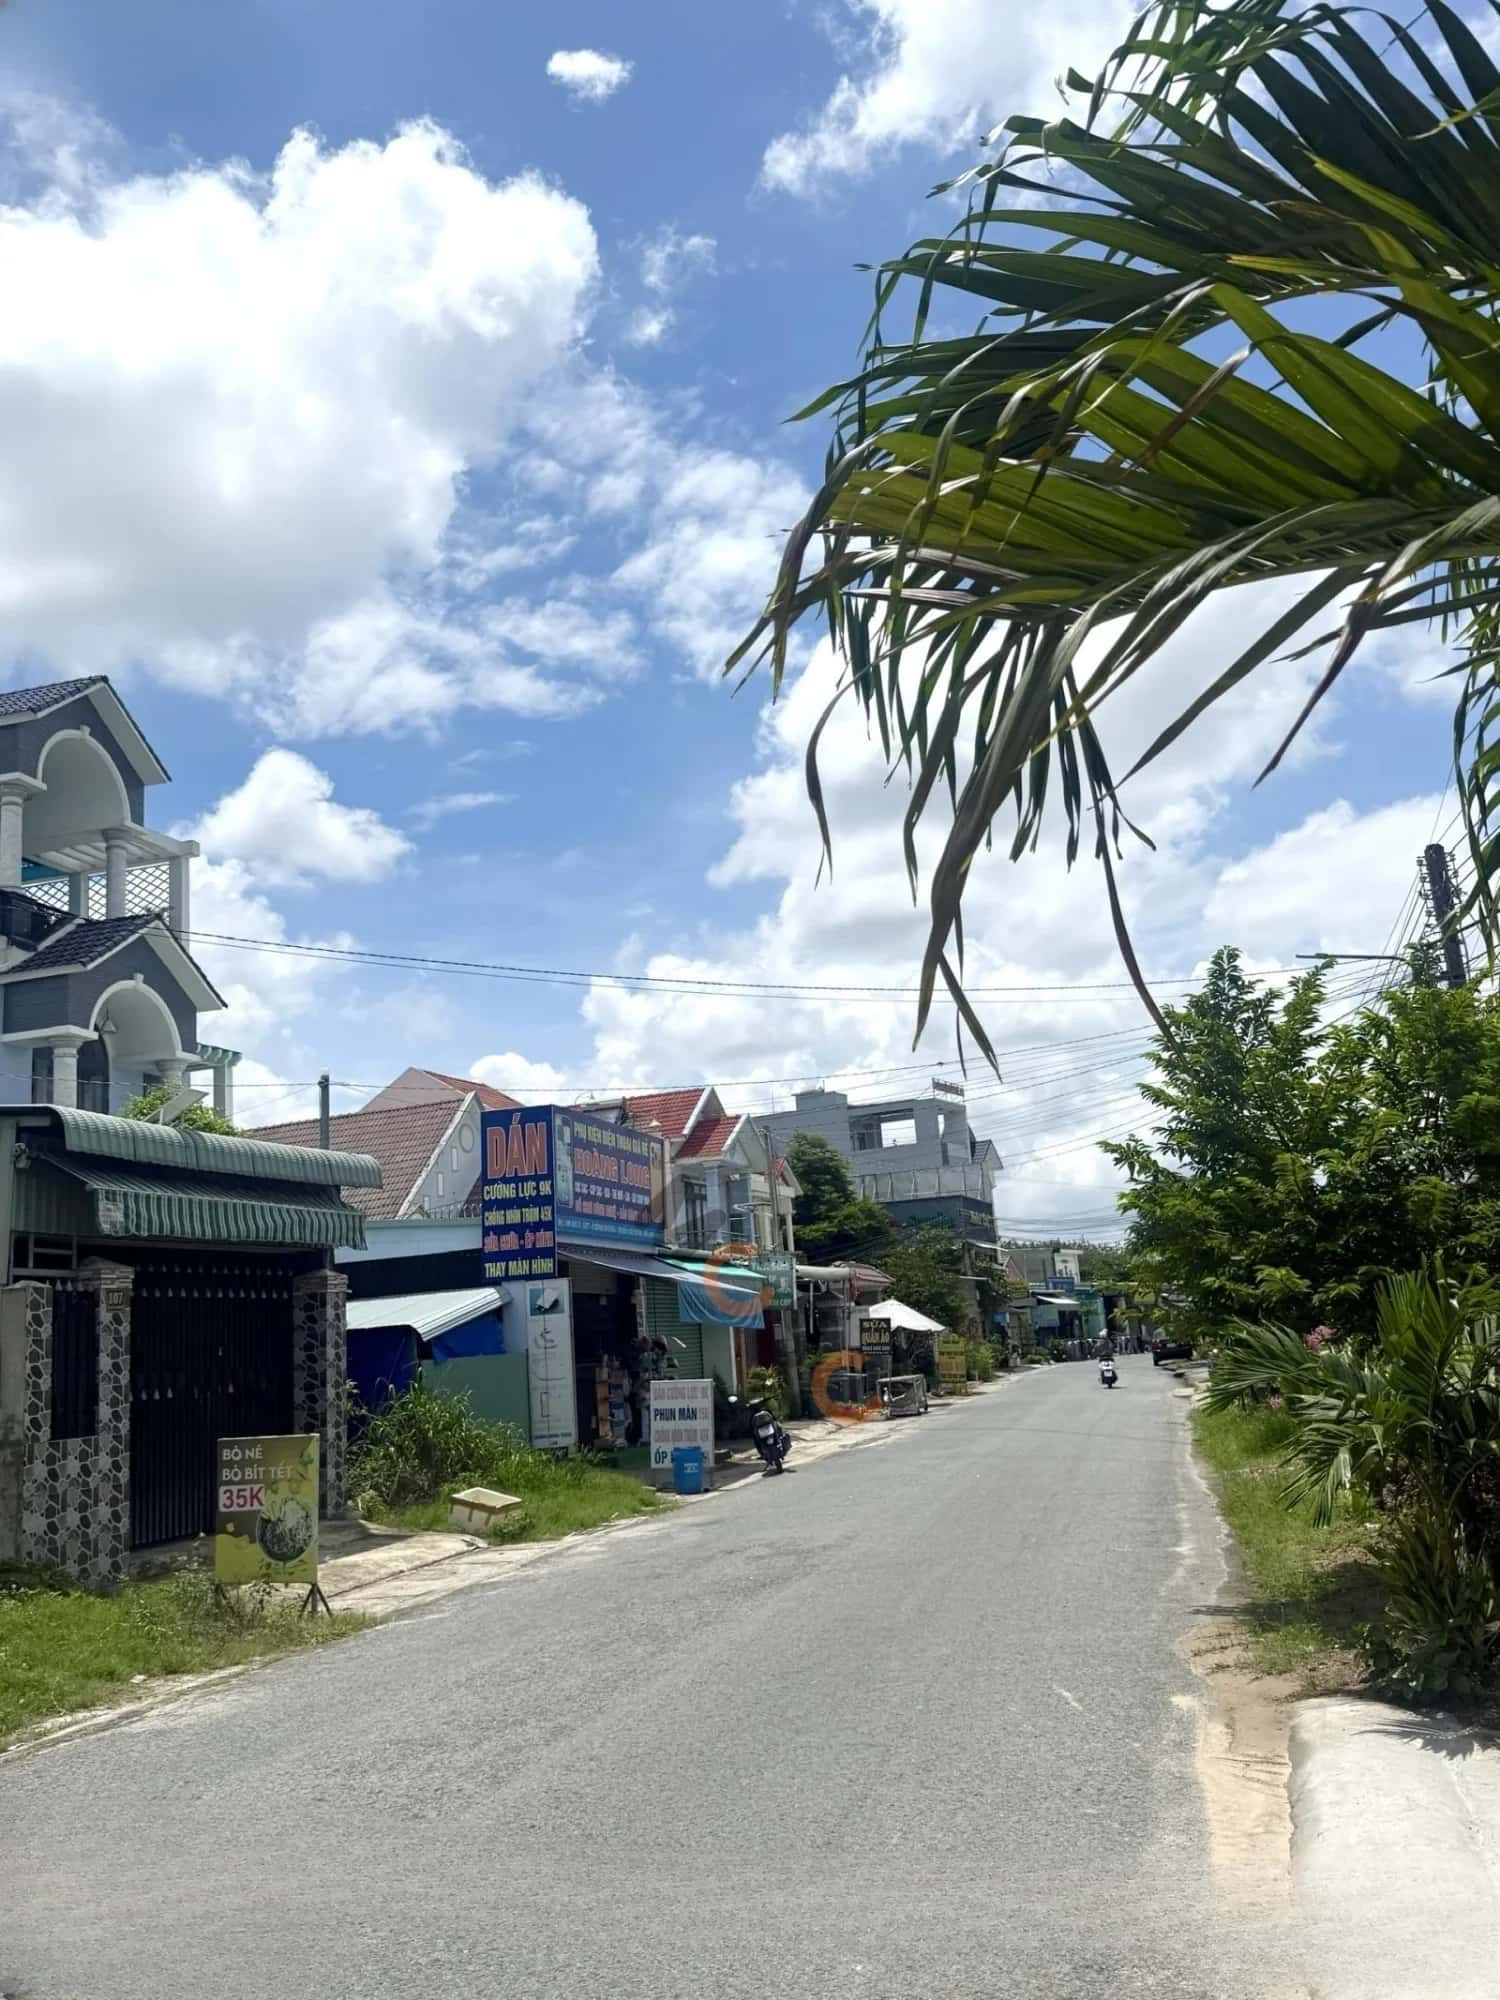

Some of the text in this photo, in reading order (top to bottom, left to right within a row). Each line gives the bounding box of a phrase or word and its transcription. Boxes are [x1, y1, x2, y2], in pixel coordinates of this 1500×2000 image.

[486, 1112, 548, 1179] DÁN
[574, 1147, 650, 1189] HOÀNG LONG
[483, 1181, 517, 1200] CƯỜNG
[518, 1180, 537, 1200] LỰC
[539, 1180, 552, 1196] 9K
[484, 1255, 554, 1279] THAY MÀN HÌNH
[654, 1407, 676, 1421] PHUN
[244, 1464, 265, 1480] BÍT
[223, 1486, 264, 1509] 35K
